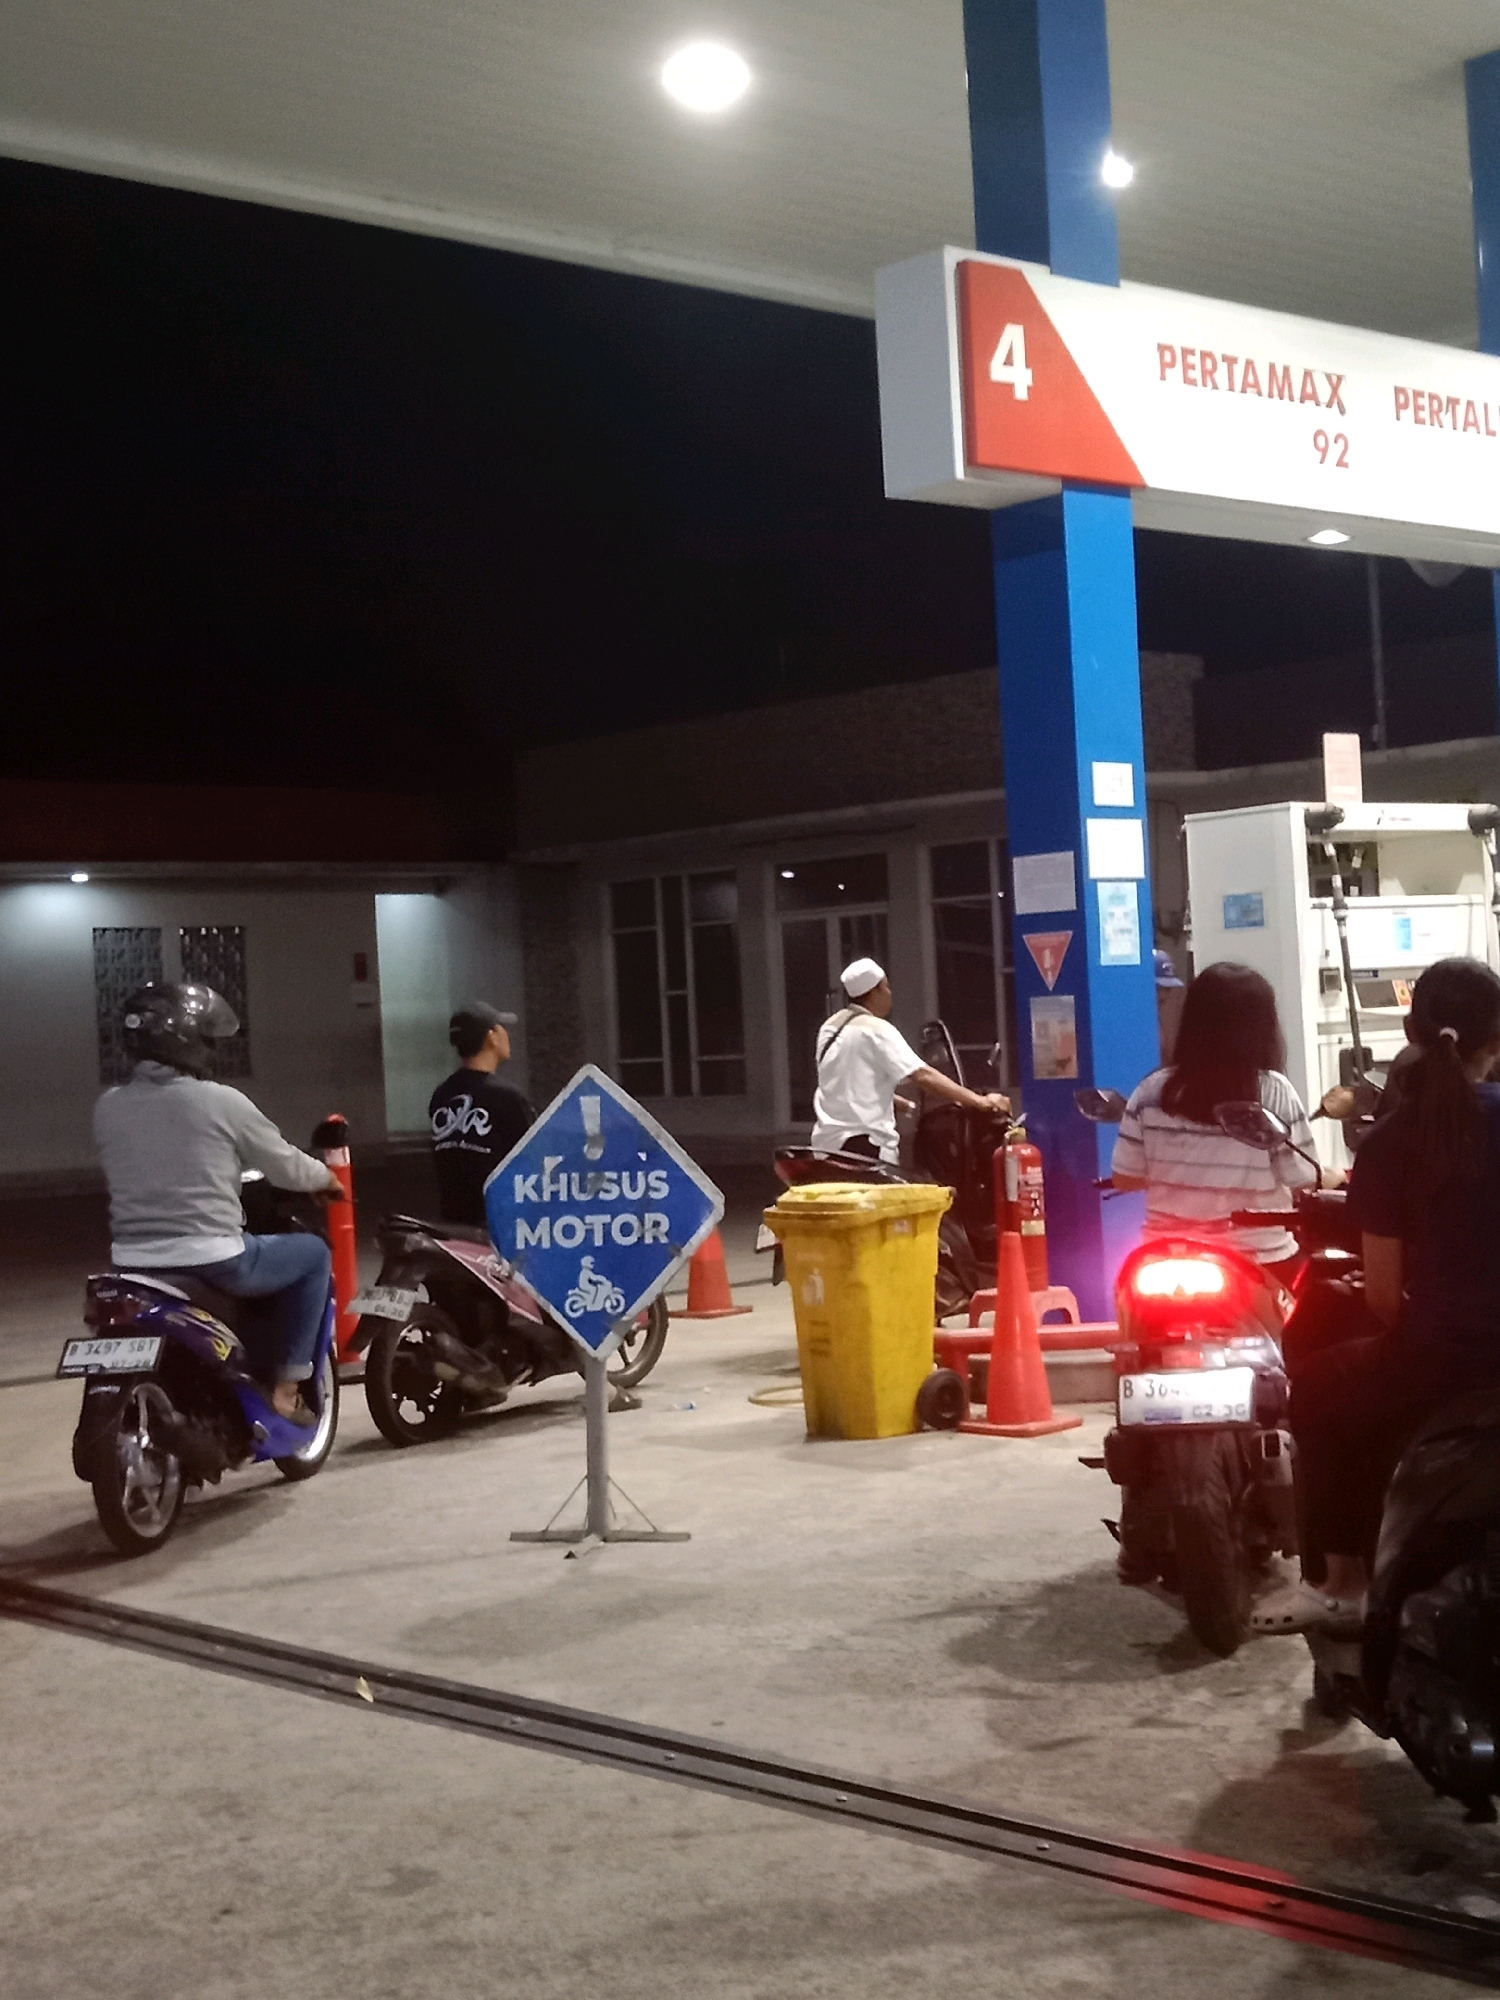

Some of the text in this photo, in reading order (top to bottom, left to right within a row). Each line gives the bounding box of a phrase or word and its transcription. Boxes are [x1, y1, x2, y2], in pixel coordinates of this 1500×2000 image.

[990, 323, 1033, 401] 4
[1156, 342, 1347, 417] PERTAMAX
[1394, 385, 1500, 438] PERTAL
[1312, 428, 1350, 469] 92
[513, 1168, 671, 1204] KHUSUS
[515, 1212, 671, 1250] MOTOR
[1123, 1379, 1135, 1399] B
